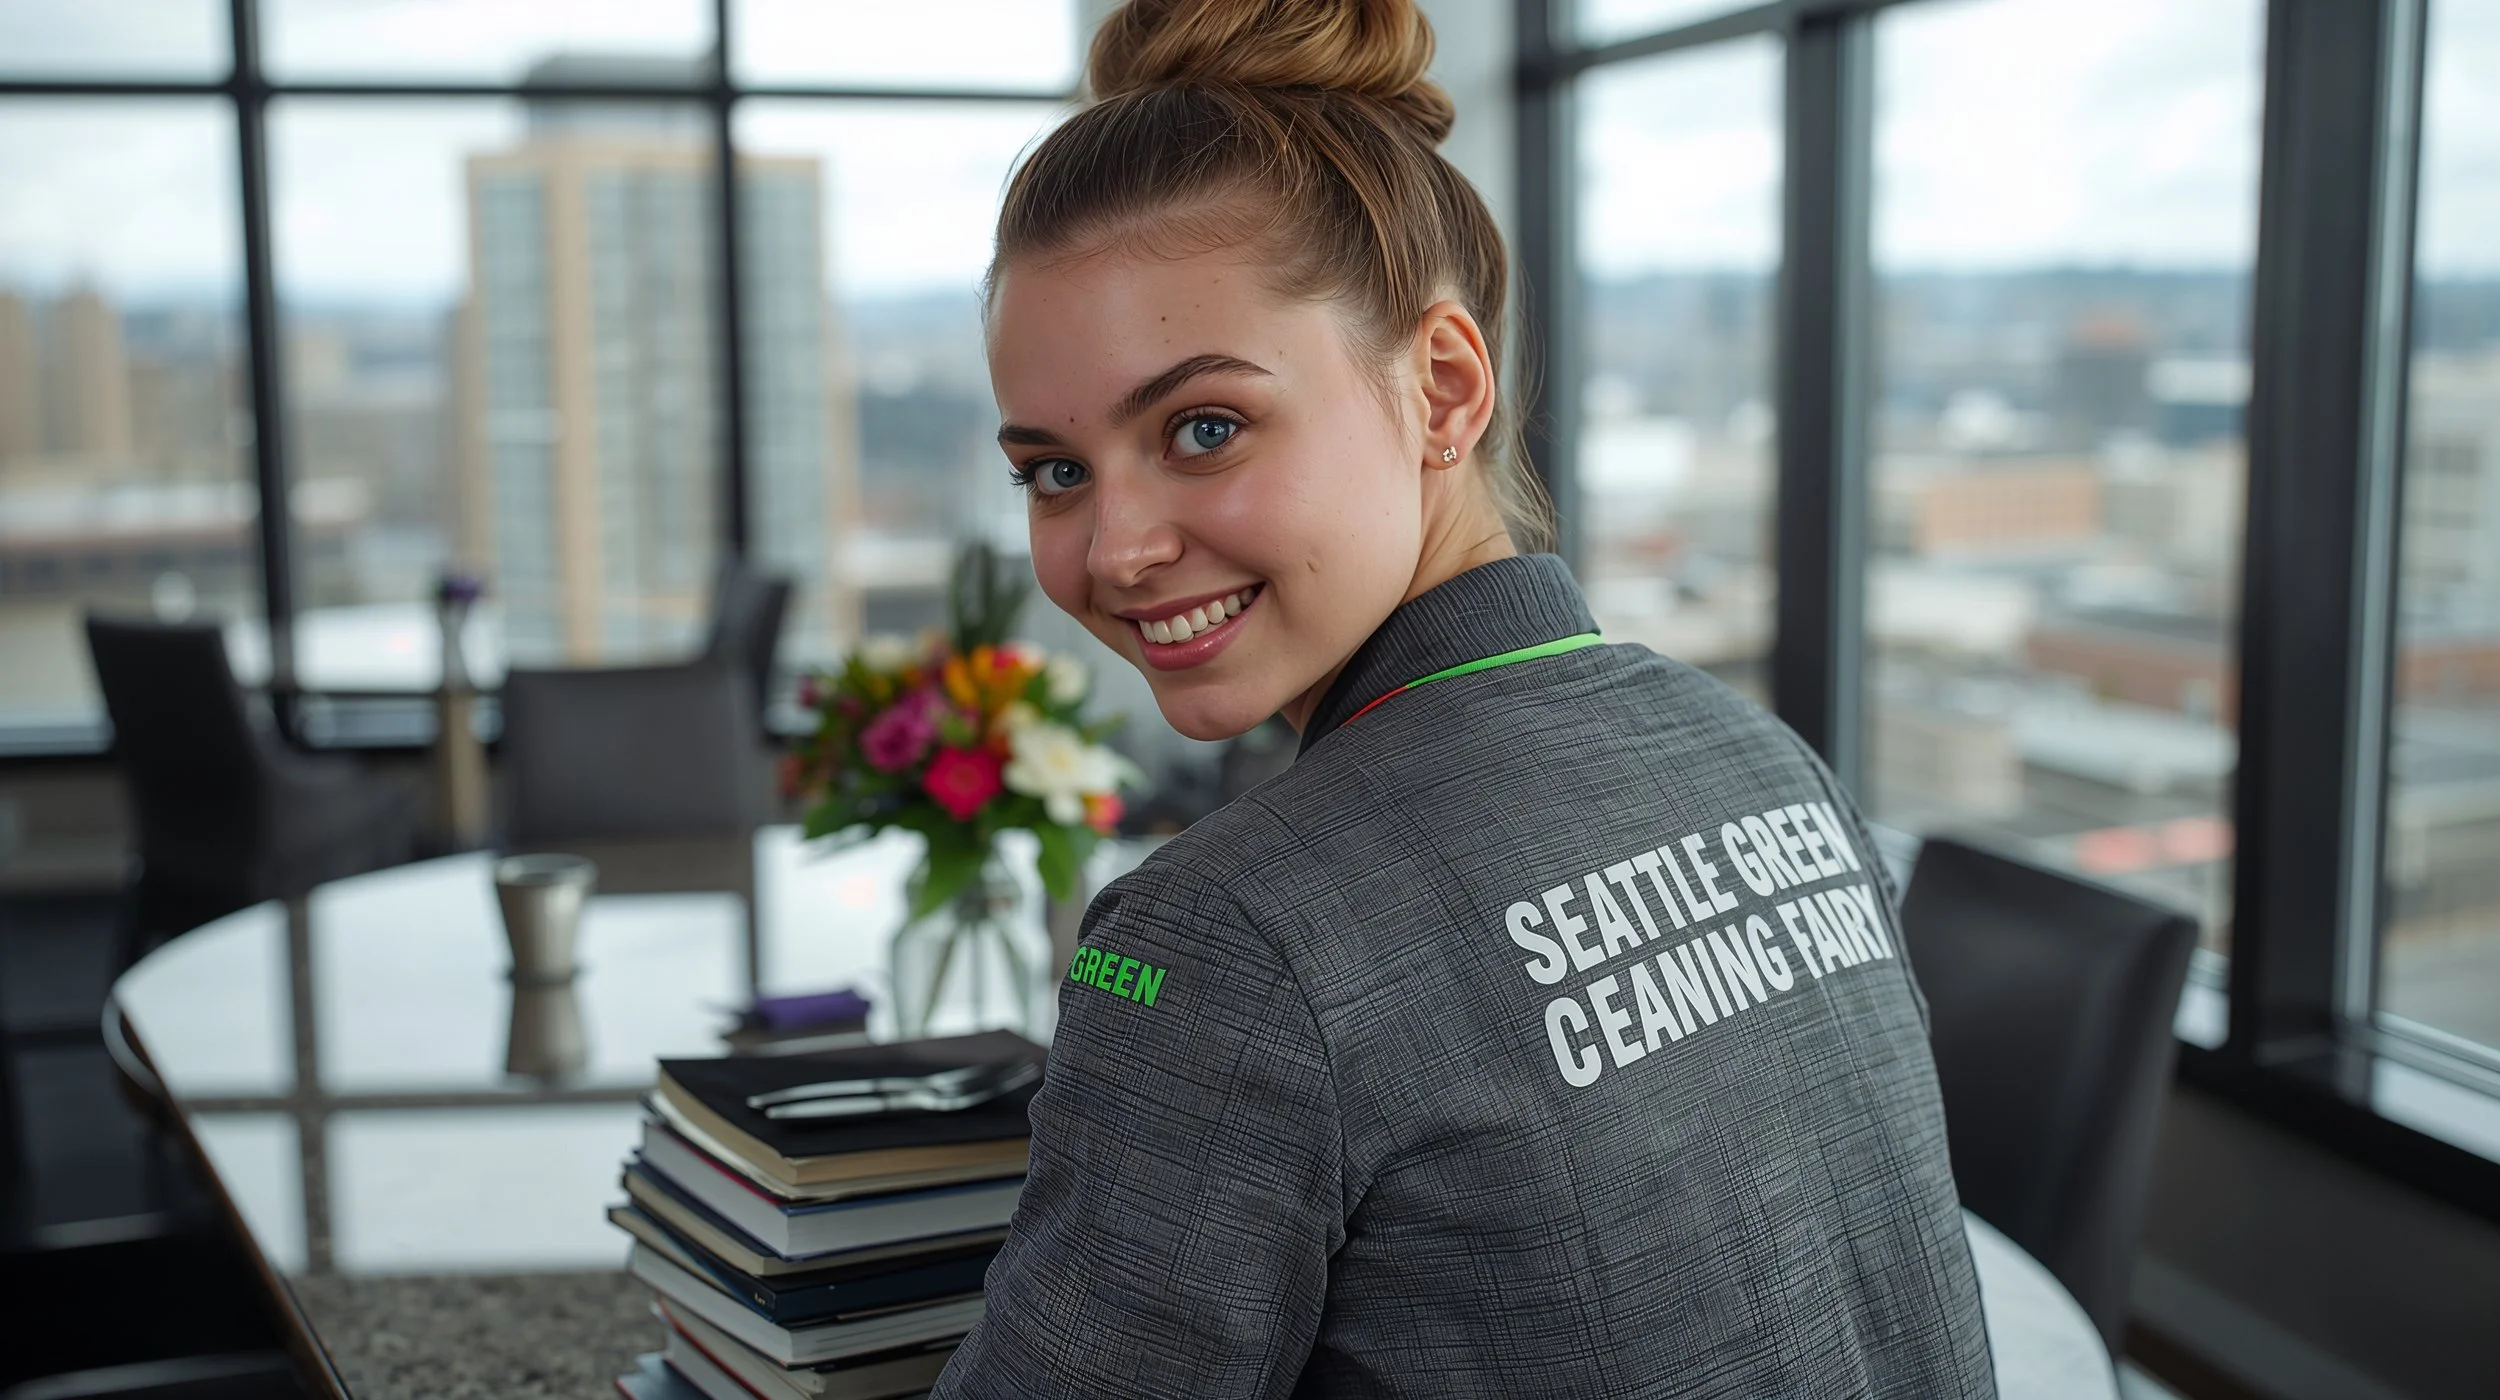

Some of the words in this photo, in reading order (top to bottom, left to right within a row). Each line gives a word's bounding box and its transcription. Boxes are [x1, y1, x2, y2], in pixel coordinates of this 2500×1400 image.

[1070, 946, 1167, 1008] GREEN
[1505, 832, 1739, 985] SEATTLE
[1721, 802, 1861, 897] GREEN
[1545, 914, 1793, 1087] CEANING
[1777, 884, 1893, 979] FAIRY
